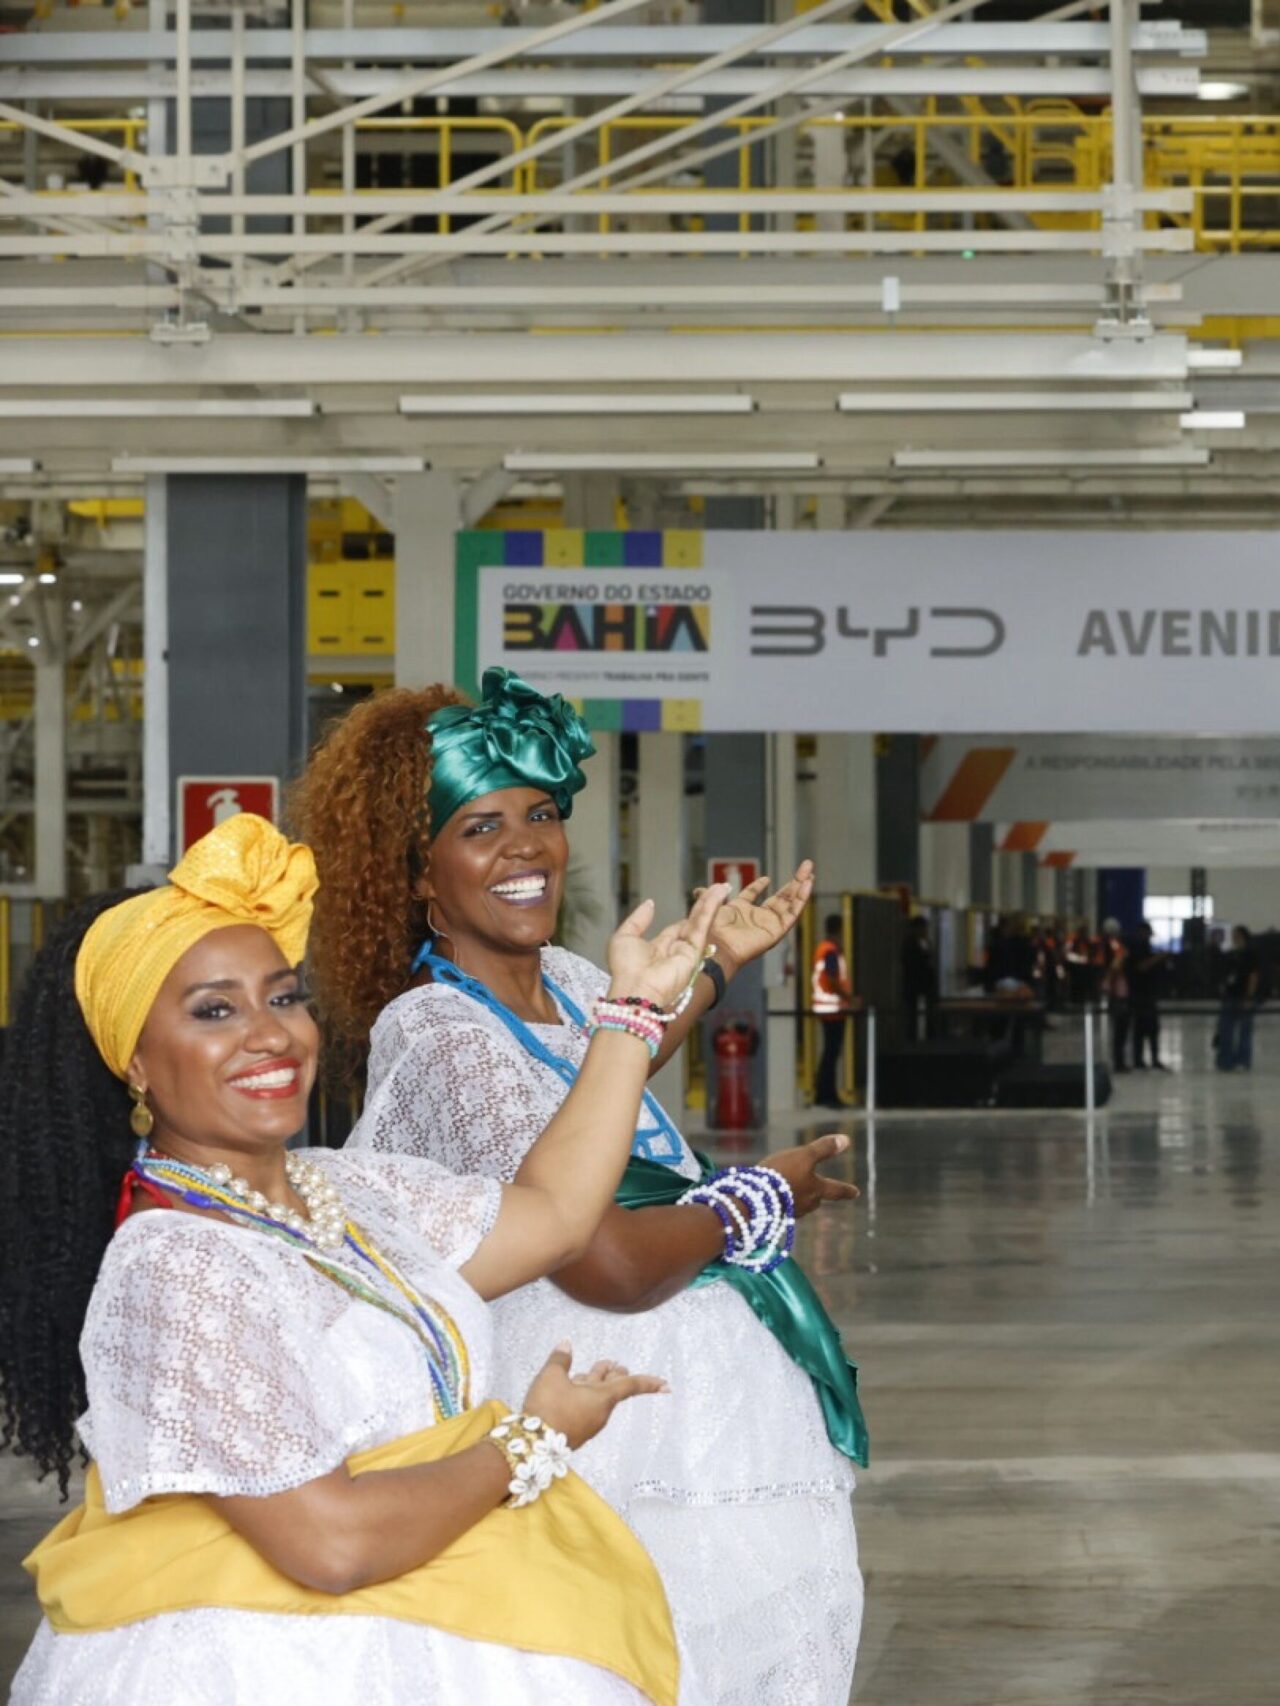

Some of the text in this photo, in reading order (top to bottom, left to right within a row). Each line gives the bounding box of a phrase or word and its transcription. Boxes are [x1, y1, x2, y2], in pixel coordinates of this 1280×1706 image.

[503, 584, 712, 601] GOVERNO DO ESTADO
[503, 603, 710, 651] BAHIA
[750, 606, 1007, 657] BYD
